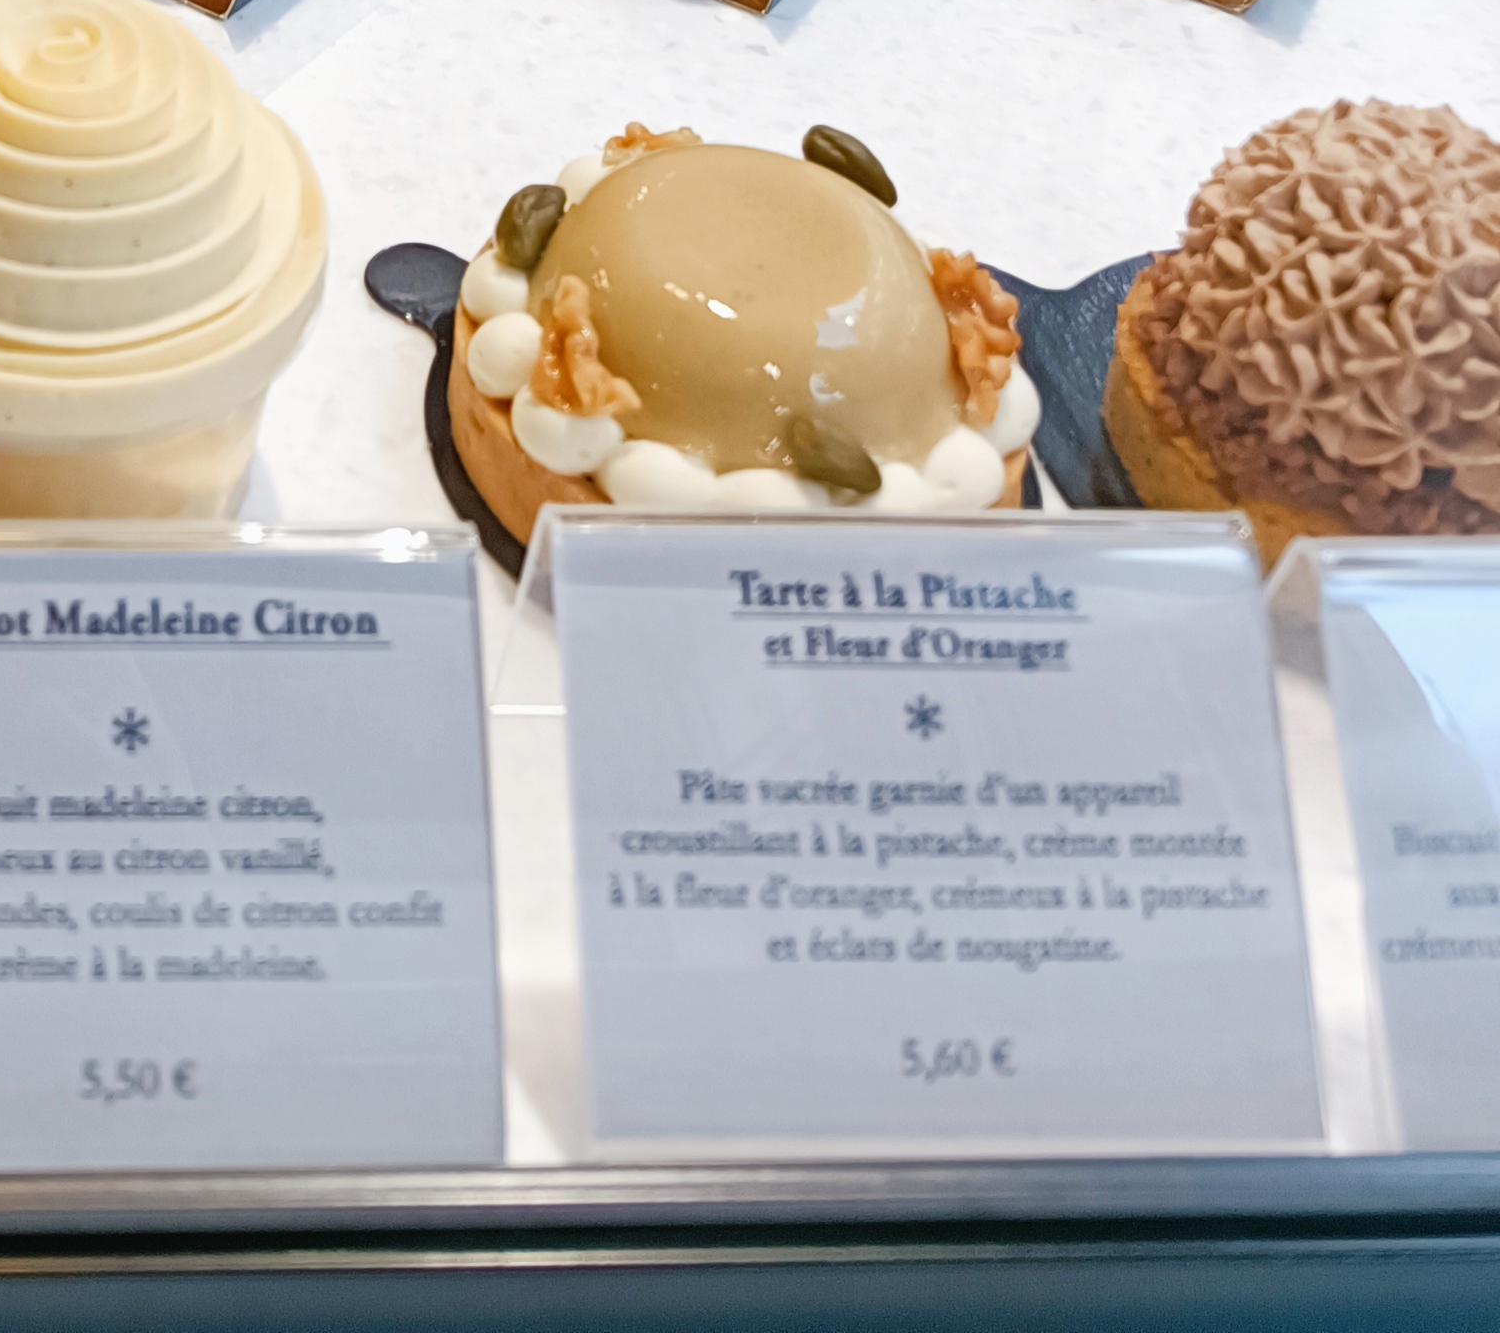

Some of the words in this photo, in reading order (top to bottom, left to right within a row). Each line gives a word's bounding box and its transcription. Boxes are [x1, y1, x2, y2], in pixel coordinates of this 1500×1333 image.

[729, 569, 829, 607] Tarte
[841, 570, 863, 608] à
[872, 568, 907, 609] la
[917, 571, 1077, 611] Pistache
[42, 597, 241, 637] Madeleine
[252, 598, 379, 637] Citron
[763, 633, 794, 657] et
[803, 625, 891, 658] Fleur
[901, 625, 1069, 670] d'Oranger
[49, 784, 208, 822] madeleine
[218, 784, 324, 826] citron,
[677, 769, 747, 805] Pâte
[756, 771, 856, 806] sucrée
[867, 769, 966, 815] garnie
[1056, 771, 1181, 817] appareil
[67, 848, 104, 875] au
[114, 837, 209, 875] citron
[620, 820, 800, 858] croustillant
[811, 821, 830, 858] à
[837, 821, 866, 858] la
[875, 821, 1017, 869] pistache,
[1024, 823, 1121, 859] crème
[1130, 823, 1247, 860] montée
[90, 890, 182, 929] coulis
[193, 890, 231, 929] de
[242, 891, 339, 929] citron
[348, 889, 444, 929] confit
[608, 871, 627, 909] à
[633, 871, 664, 909] la
[674, 870, 749, 910] fleur
[930, 873, 1067, 911] crémeux
[1076, 873, 1094, 911] à
[1102, 873, 1133, 911] la
[1140, 873, 1269, 922] pistache
[91, 944, 107, 982] à
[116, 944, 143, 982] la
[766, 936, 800, 963] et
[808, 927, 898, 963] éclats
[905, 927, 948, 963] de
[79, 1057, 161, 1106] 5,50
[170, 1057, 199, 1100] €
[900, 1036, 982, 1085] 5,60
[990, 1036, 1018, 1078] €
